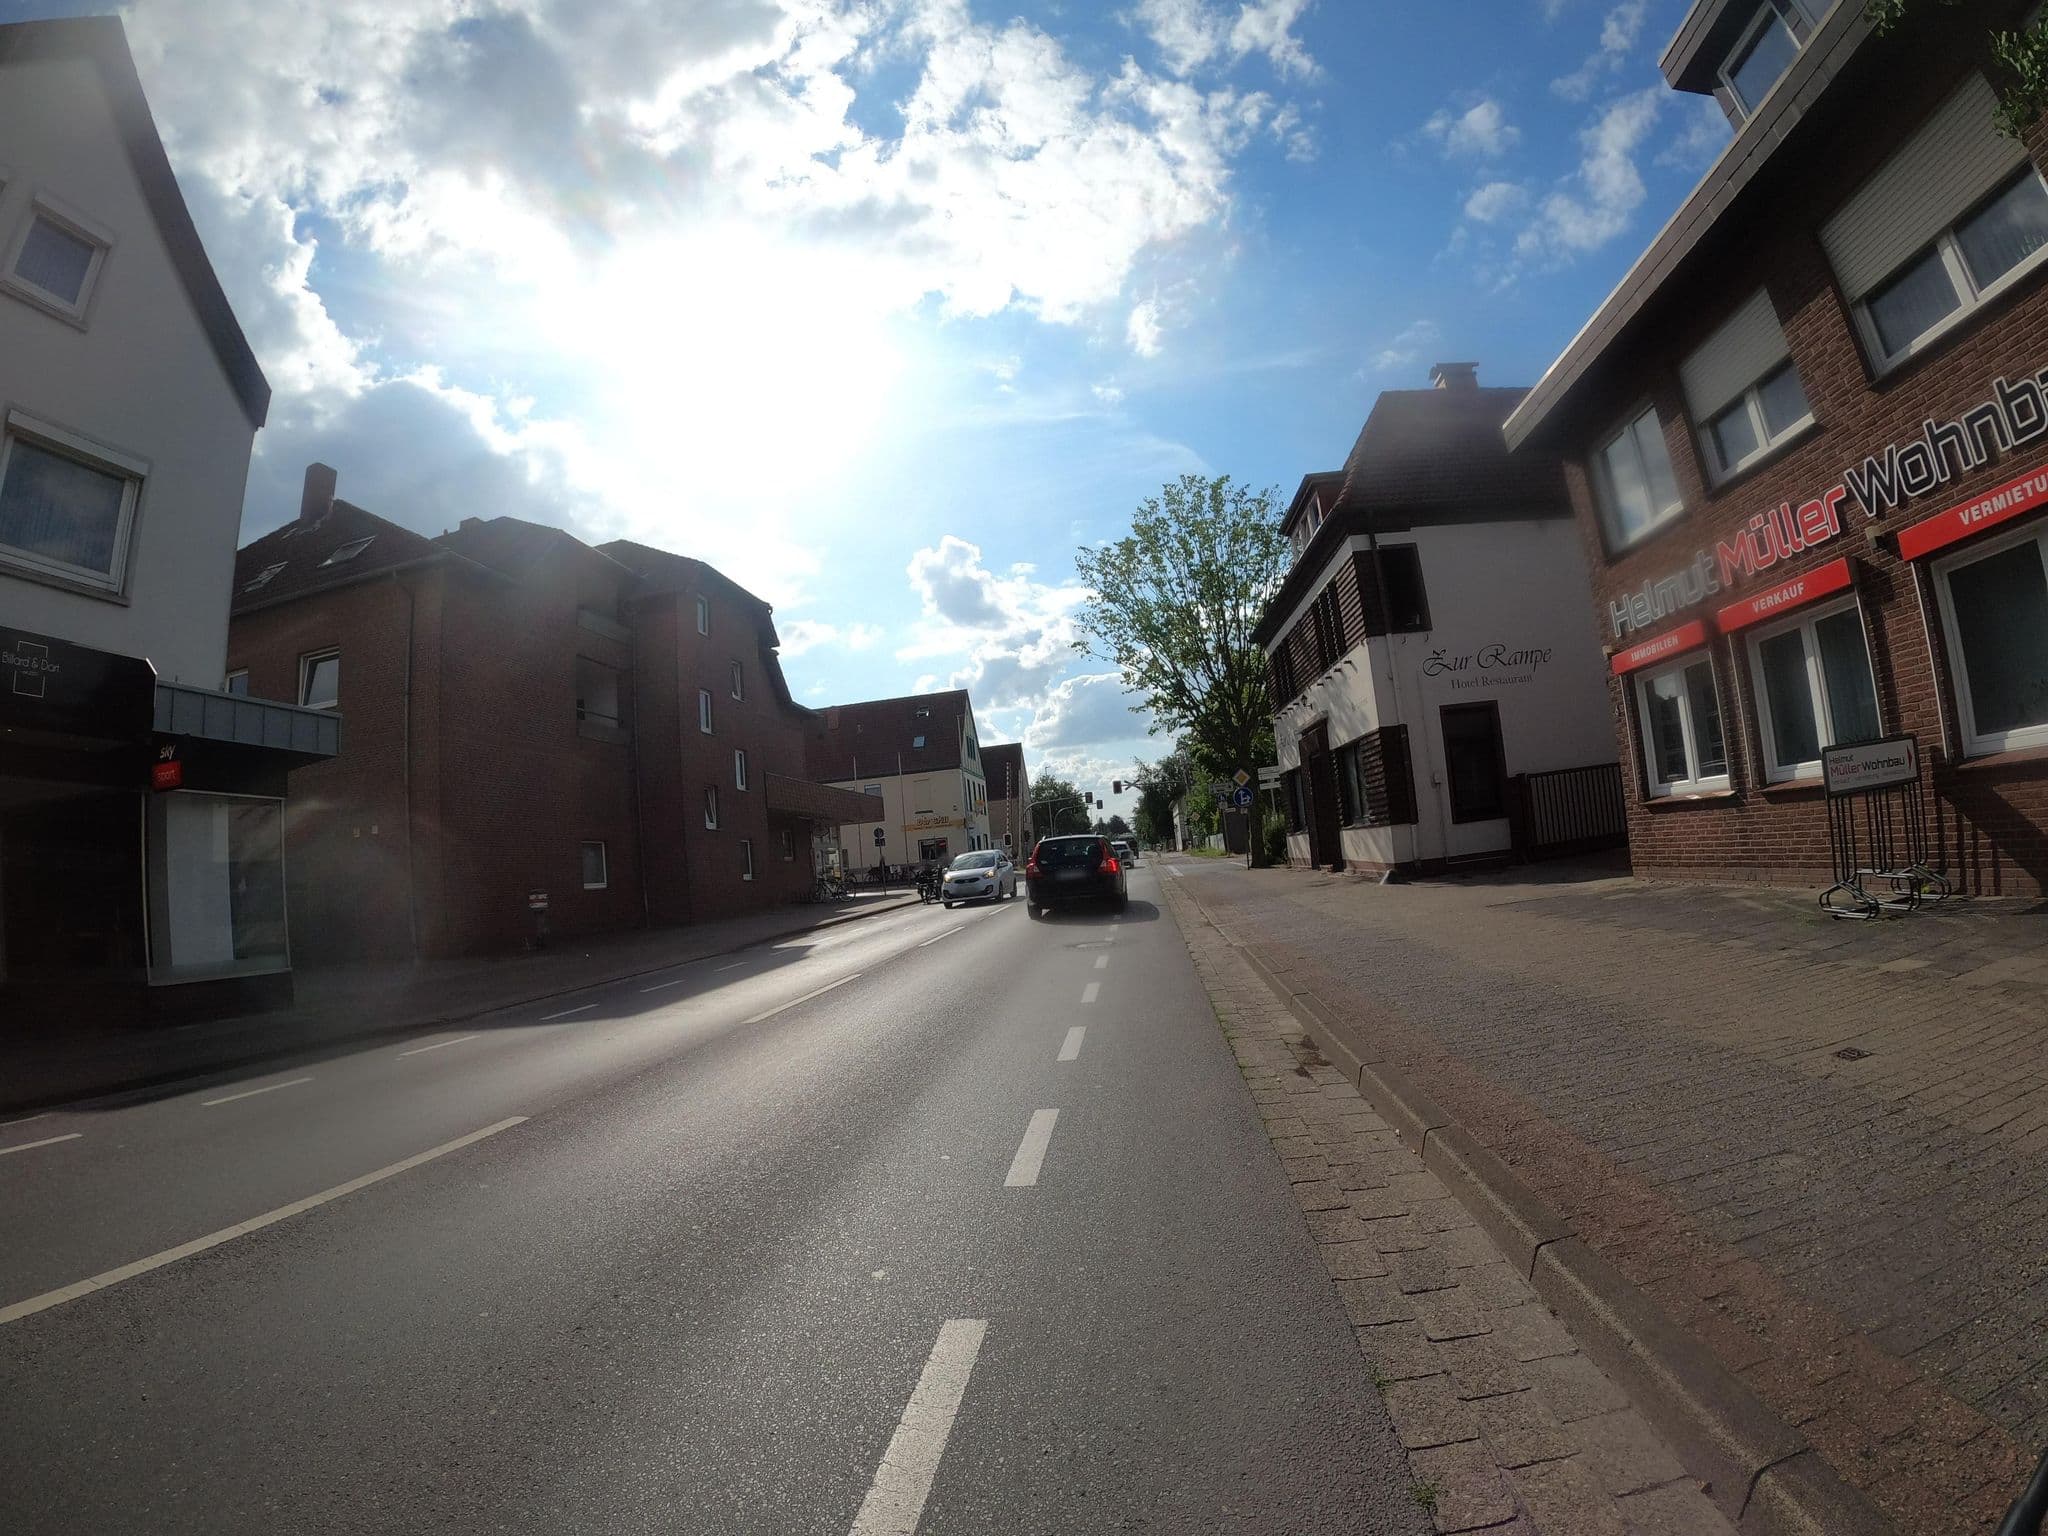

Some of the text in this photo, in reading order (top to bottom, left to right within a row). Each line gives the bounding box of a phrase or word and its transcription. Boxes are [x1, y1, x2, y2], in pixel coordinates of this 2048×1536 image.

[1958, 471, 2048, 526] VERMIETU
[1610, 549, 1721, 638] Helmut
[1715, 484, 1848, 587] Müller
[1751, 582, 1806, 613] VERKAUF
[1422, 642, 1553, 677] Zur Rampe
[1630, 634, 1680, 663] IMMOBILIEN
[1451, 673, 1534, 690] Hotel Restaurant
[159, 743, 176, 760] sky
[1829, 752, 1854, 764] Helmut
